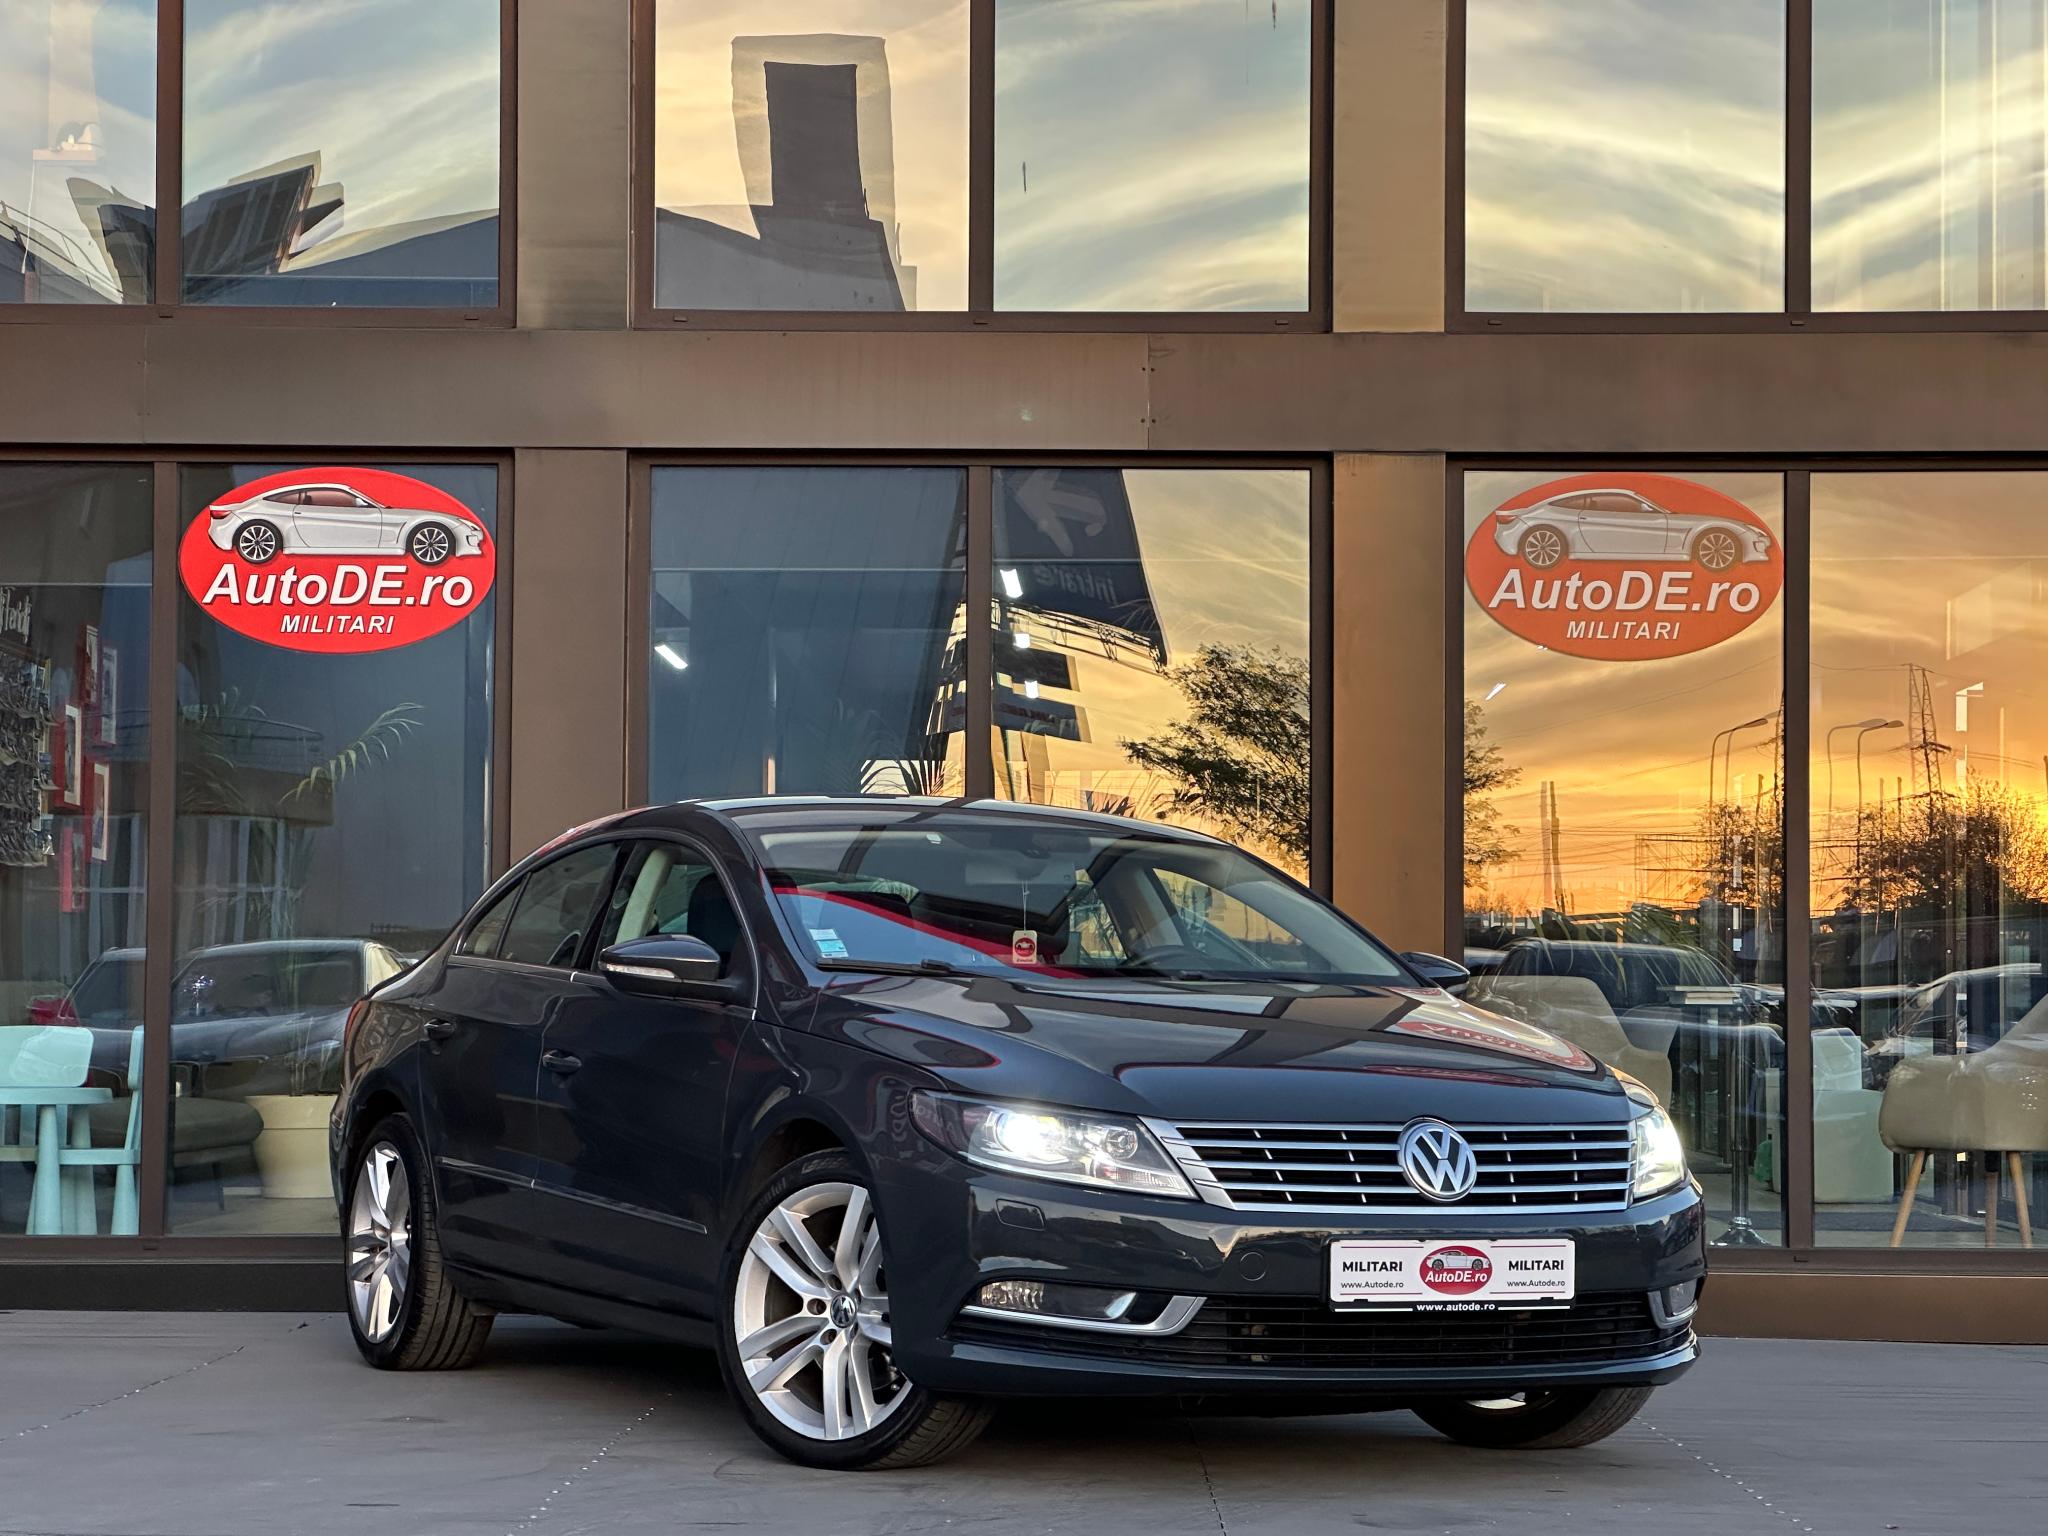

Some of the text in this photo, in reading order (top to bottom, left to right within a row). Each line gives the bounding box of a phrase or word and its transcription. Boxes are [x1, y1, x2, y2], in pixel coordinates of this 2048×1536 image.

[202, 563, 473, 606] AutoDE.ro
[1488, 568, 1760, 612] AutoDE.ro
[280, 614, 394, 634] MILITARI
[1566, 620, 1680, 639] MILITARI
[1342, 1261, 1403, 1273] MILITARI
[1508, 1259, 1564, 1271] MILITARI
[1424, 1270, 1488, 1284] AutoDE.ro
[1506, 1279, 1566, 1288] www.Autode.ro
[1340, 1280, 1404, 1289] www.Autode.ro
[1416, 1303, 1496, 1312] www.autode.ro
